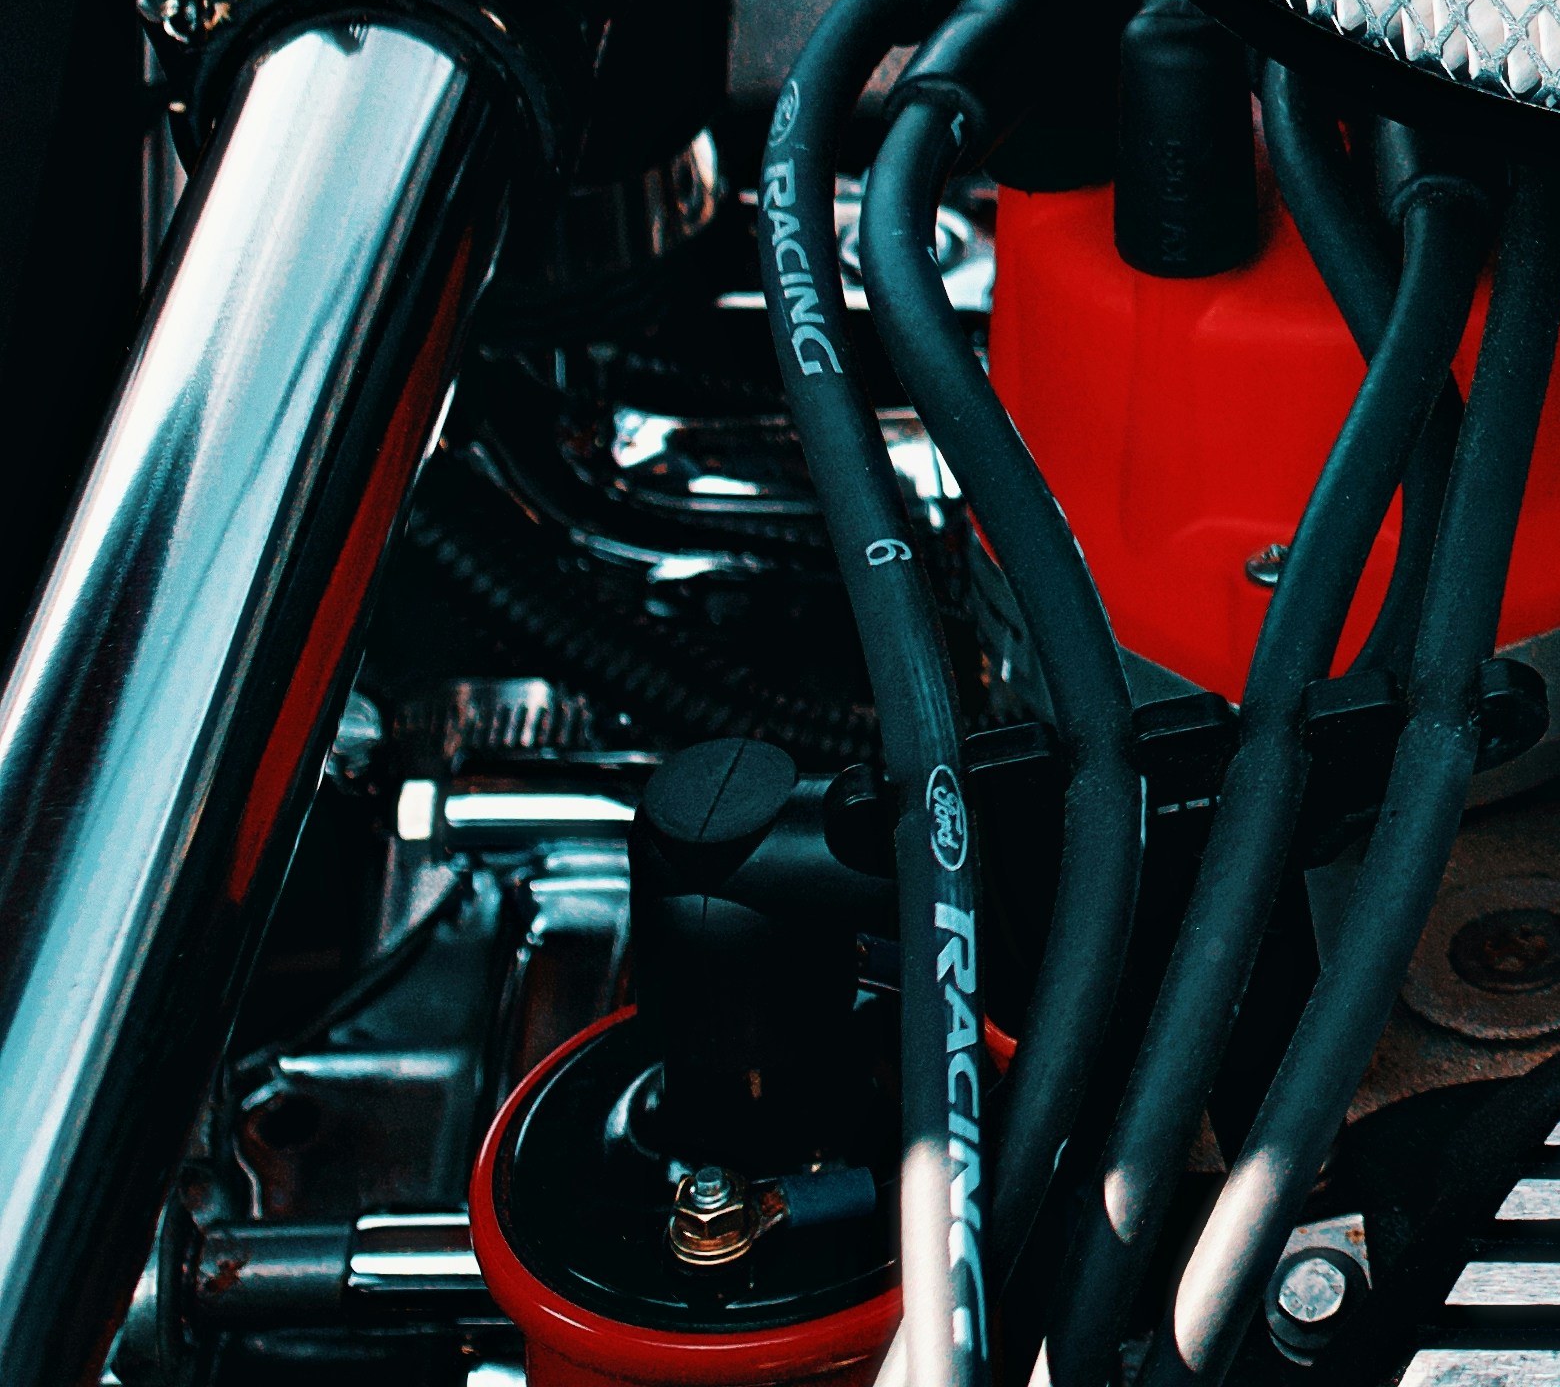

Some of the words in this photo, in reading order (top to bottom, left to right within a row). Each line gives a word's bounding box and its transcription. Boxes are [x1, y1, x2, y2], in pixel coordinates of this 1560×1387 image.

[763, 158, 843, 376] RACING
[932, 786, 963, 850] Ford
[934, 901, 988, 1361] RACING
